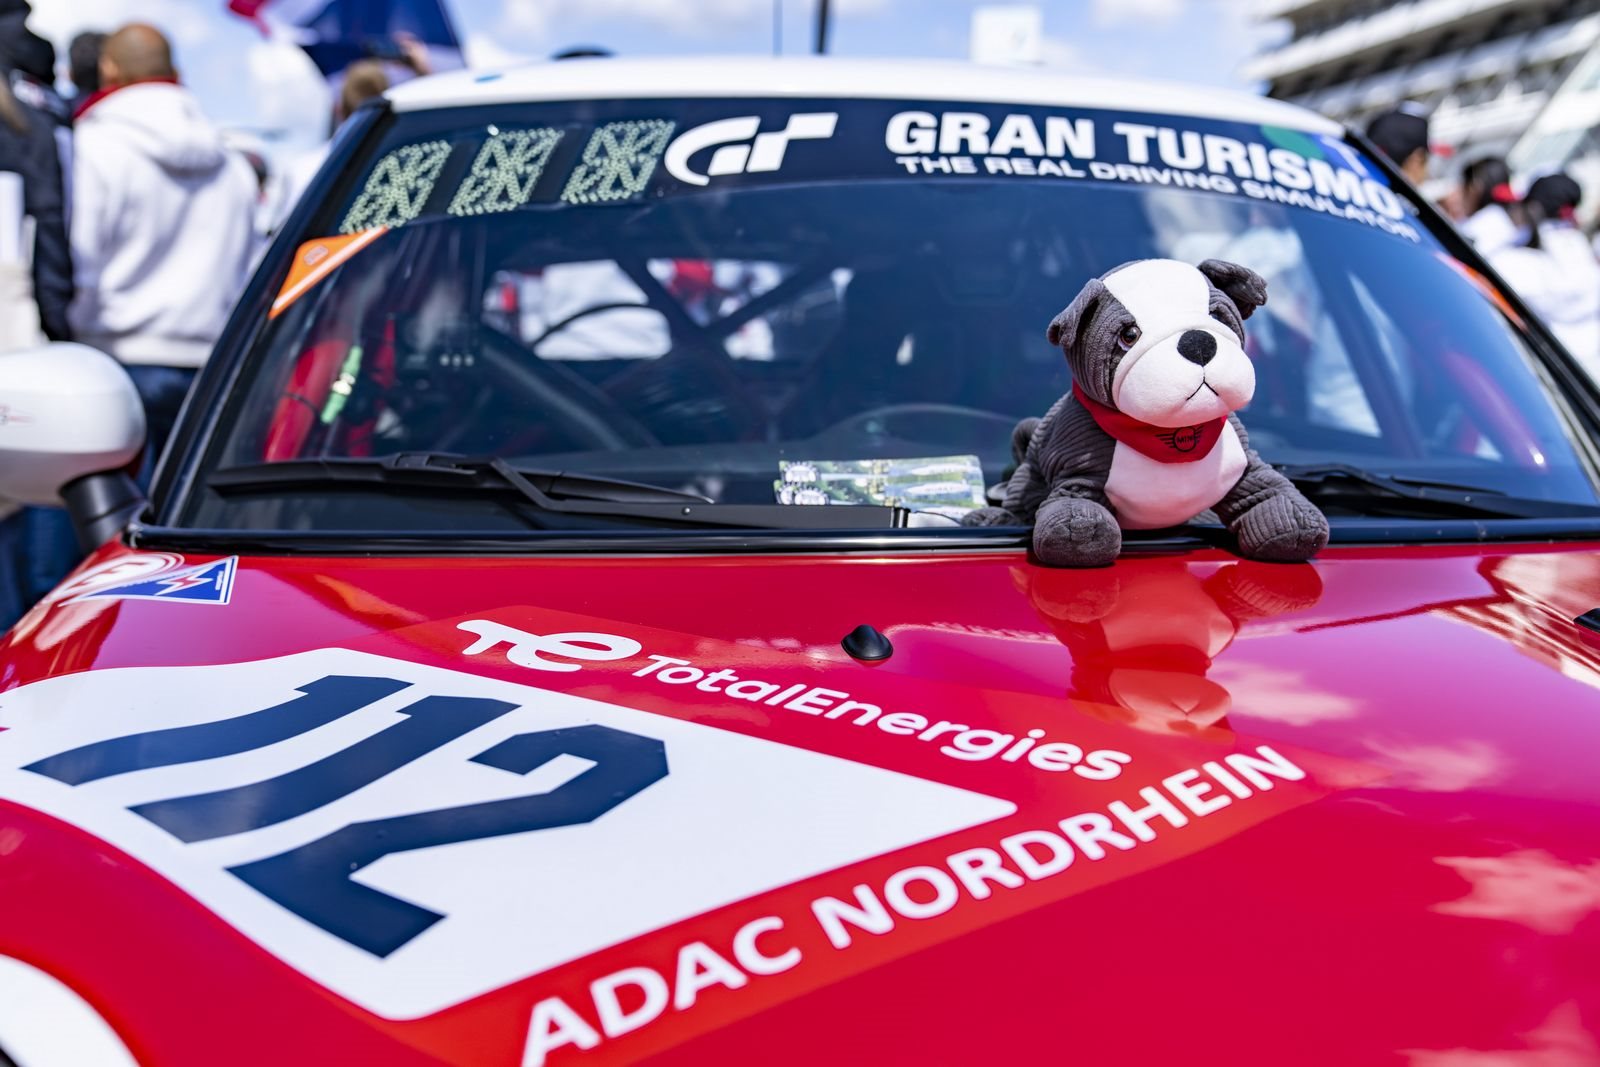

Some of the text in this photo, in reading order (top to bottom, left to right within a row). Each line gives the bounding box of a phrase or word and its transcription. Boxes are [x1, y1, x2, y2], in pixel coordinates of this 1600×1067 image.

[885, 111, 1406, 221] GRAN TURISMO
[896, 156, 977, 174] THE
[984, 158, 1086, 178] REAL
[1090, 161, 1238, 194] DRIVING
[1241, 179, 1421, 244] SIMULATOR
[632, 654, 1132, 781] TotalEnergies
[20, 675, 669, 958] 112
[521, 744, 1307, 1067] ADAC NORDRHEIN
